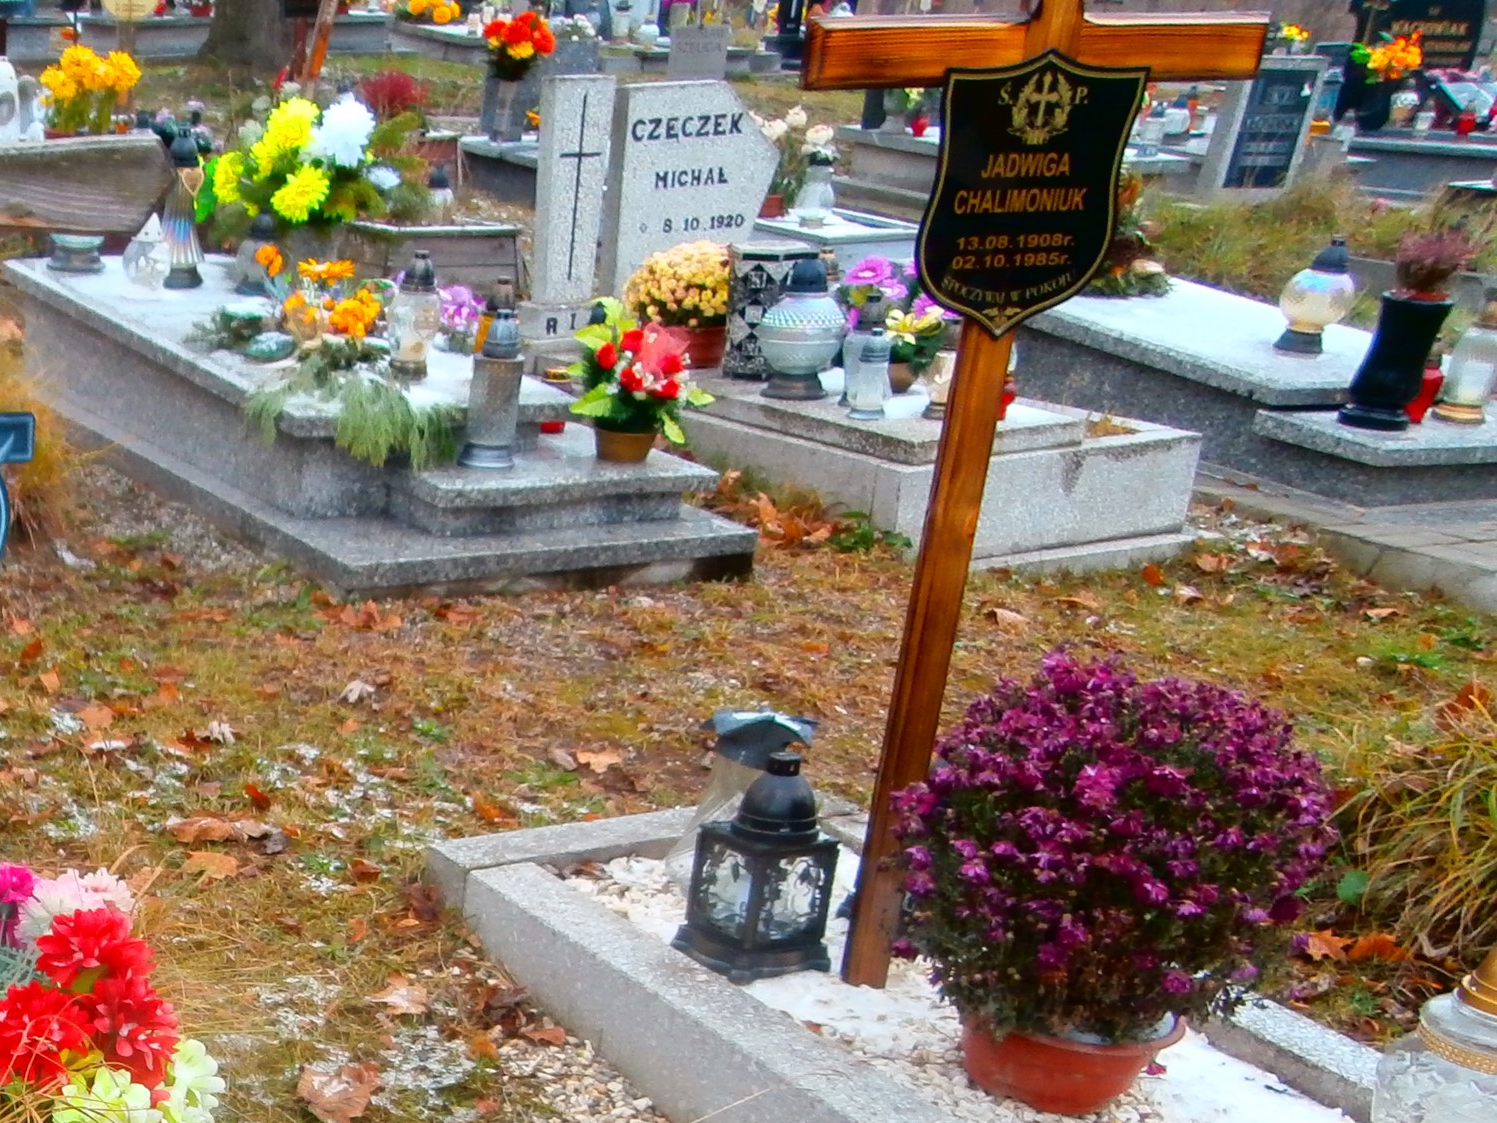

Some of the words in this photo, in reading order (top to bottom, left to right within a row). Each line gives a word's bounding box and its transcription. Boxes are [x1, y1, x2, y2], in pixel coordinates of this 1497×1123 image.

[631, 112, 744, 143] CZĘCZEK
[981, 152, 1070, 178] JADWIGA
[654, 166, 729, 190] MICHAŁ
[953, 186, 1087, 214] CHALIMONIUK
[956, 232, 1076, 251] 13.08.1908r.
[951, 251, 1072, 270] 02.10.1985r.
